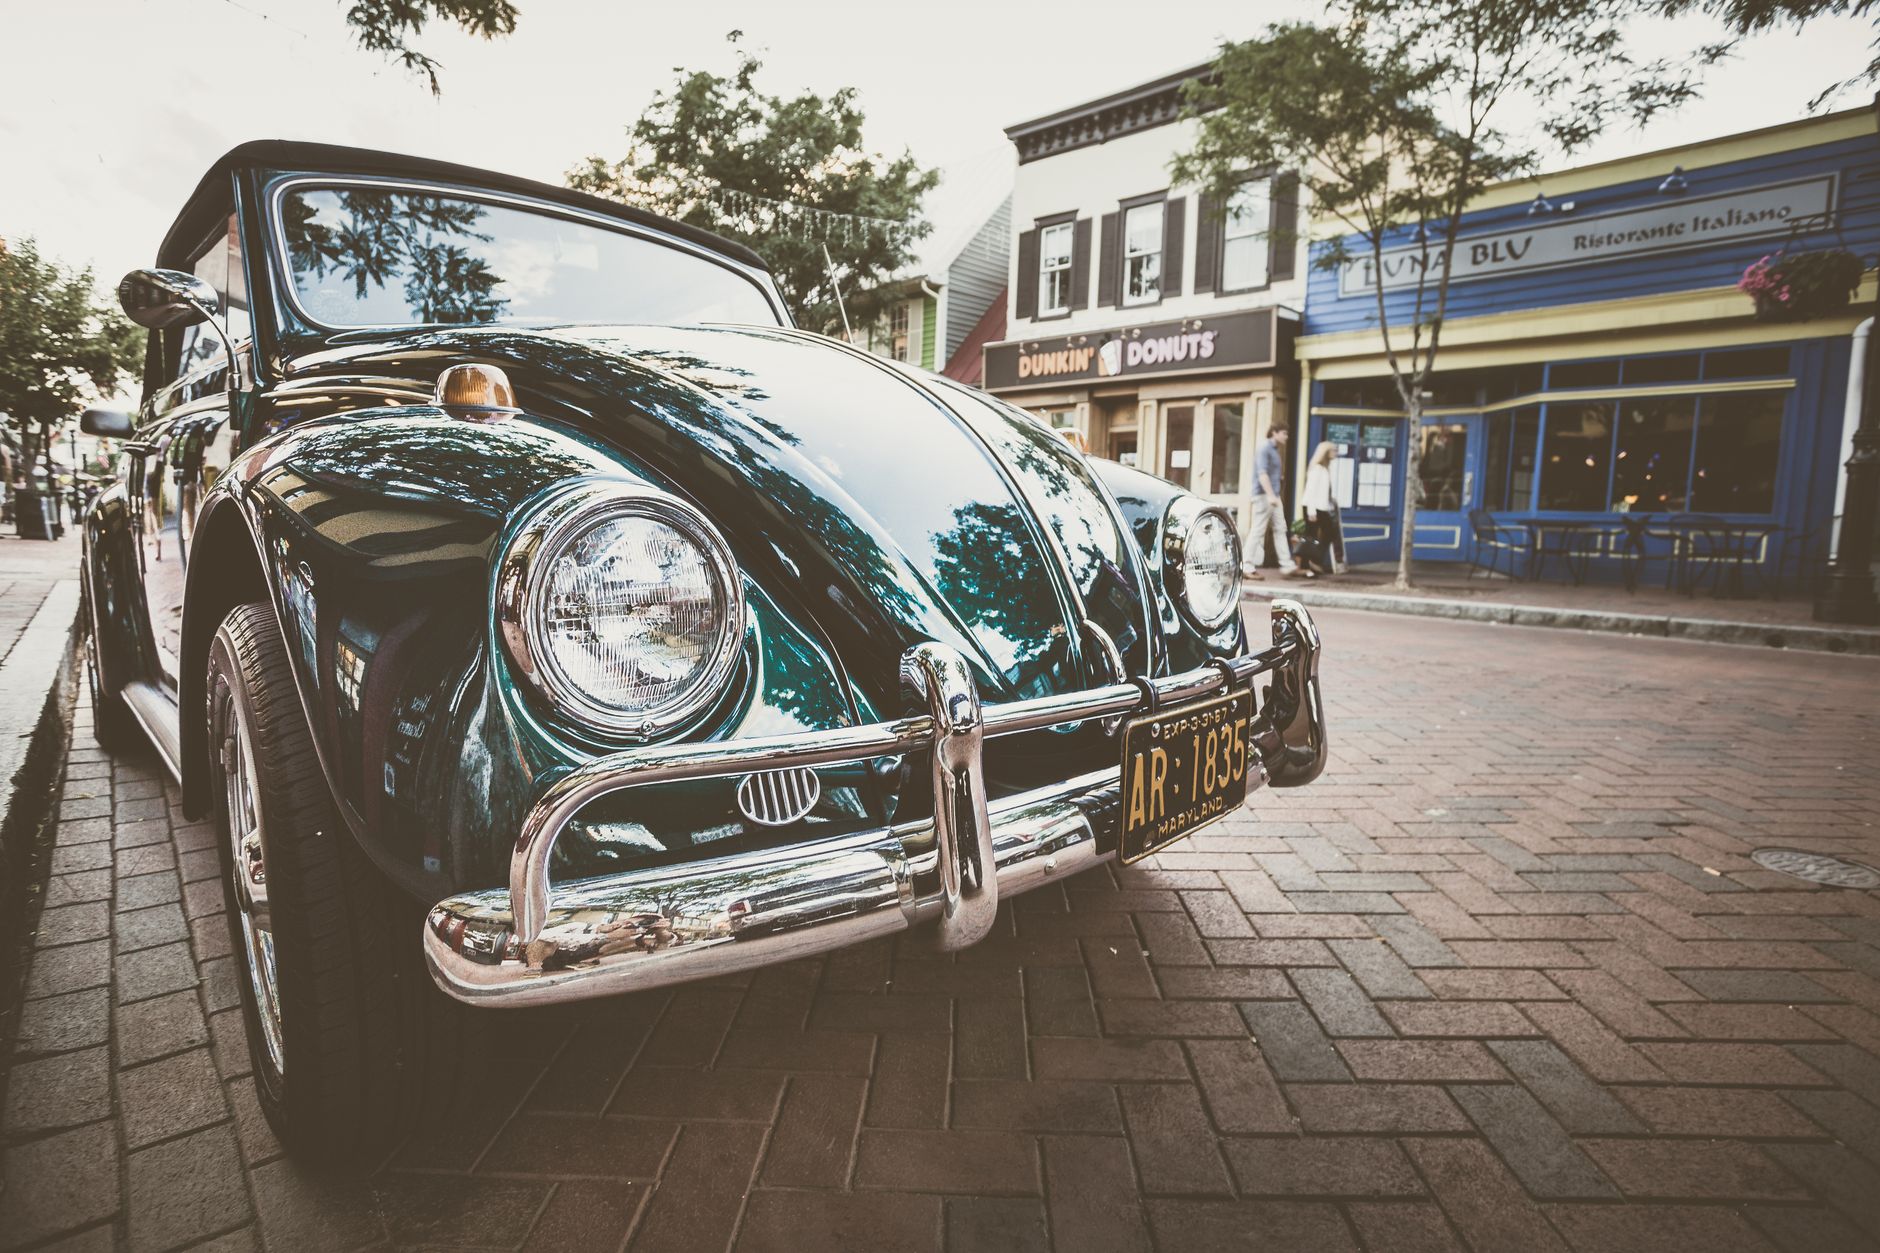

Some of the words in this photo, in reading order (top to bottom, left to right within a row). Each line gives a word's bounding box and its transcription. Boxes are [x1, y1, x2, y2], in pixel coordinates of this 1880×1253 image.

[1573, 220, 1686, 251] Ristorante
[1692, 205, 1792, 233] Italiano
[1470, 236, 1533, 266] BLU
[1018, 347, 1095, 379] DUNKIN'
[1127, 331, 1216, 367] DONUTS
[1157, 796, 1224, 839] MARYLAND
